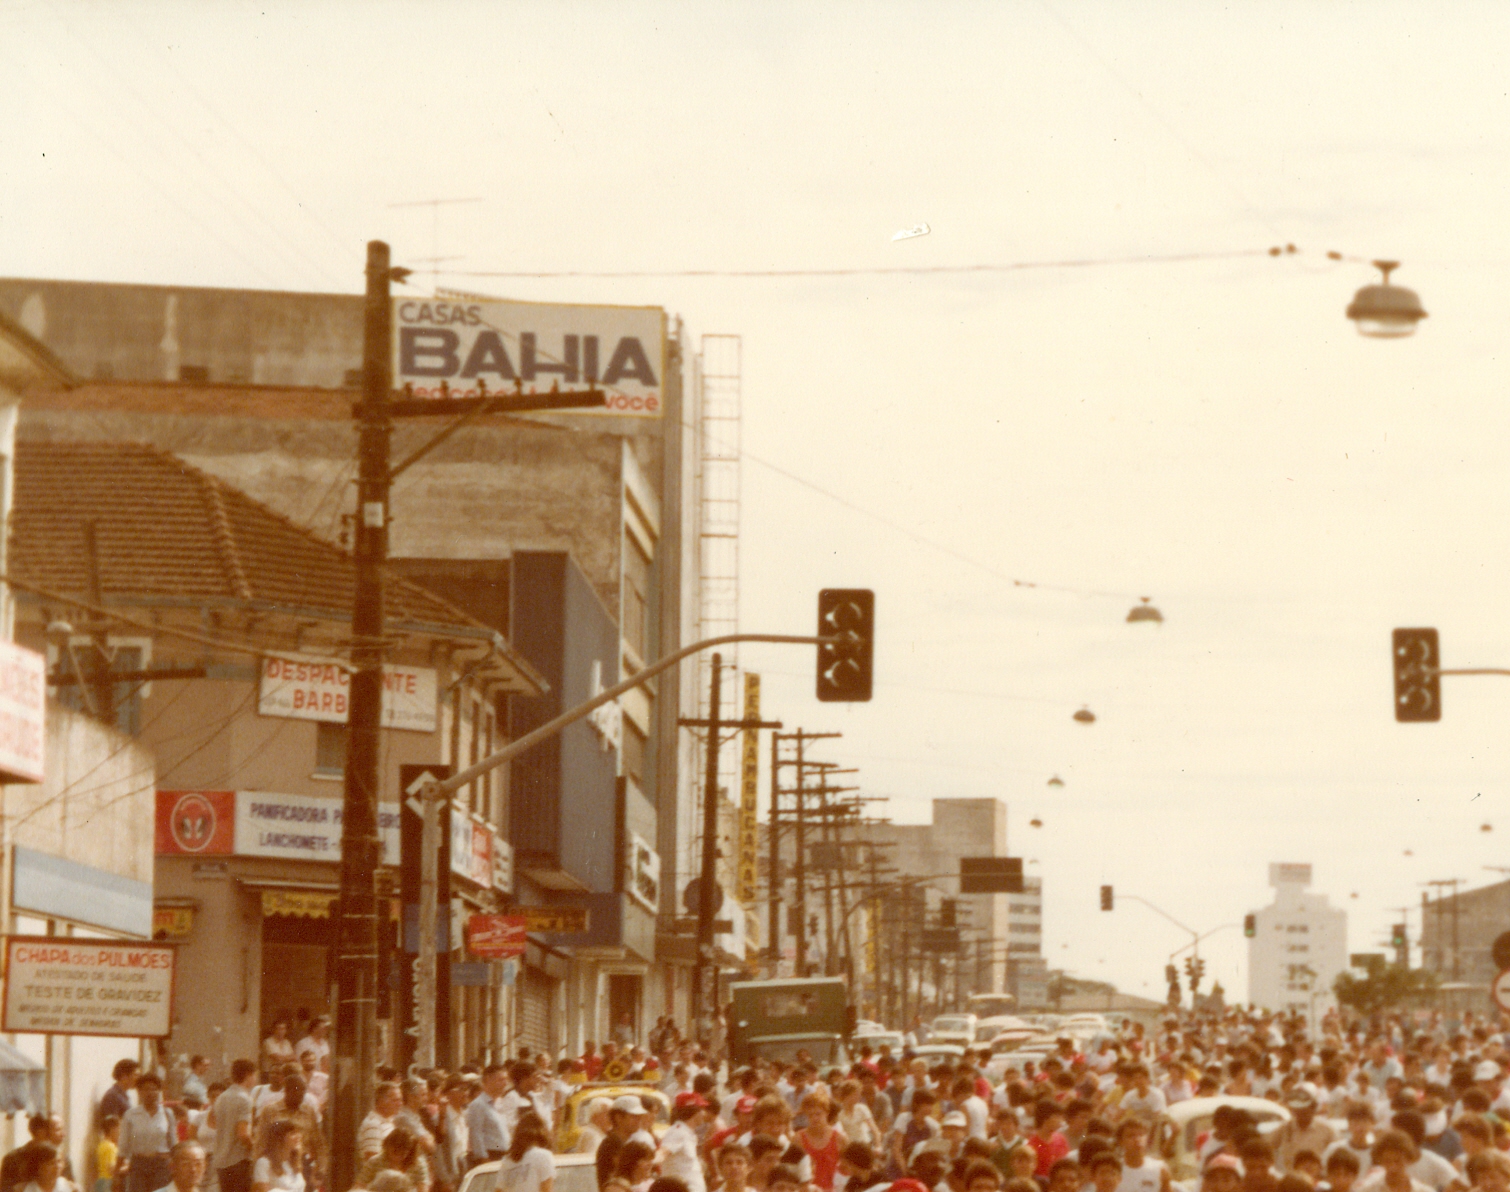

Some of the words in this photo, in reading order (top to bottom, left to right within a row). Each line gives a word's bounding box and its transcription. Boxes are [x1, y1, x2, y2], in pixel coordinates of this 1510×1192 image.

[399, 301, 482, 326] CASAS
[399, 326, 660, 388] BAHIA
[250, 803, 328, 824] PANIFICADORA
[259, 832, 330, 852] LANCHONETE
[15, 947, 71, 964] CHAPA
[72, 953, 97, 966] dos
[34, 969, 88, 981] ATESTADO
[91, 971, 105, 982] DE
[24, 985, 72, 1000] TESTE
[77, 986, 95, 1000] DE
[99, 988, 162, 1003] GRAVIDEZ
